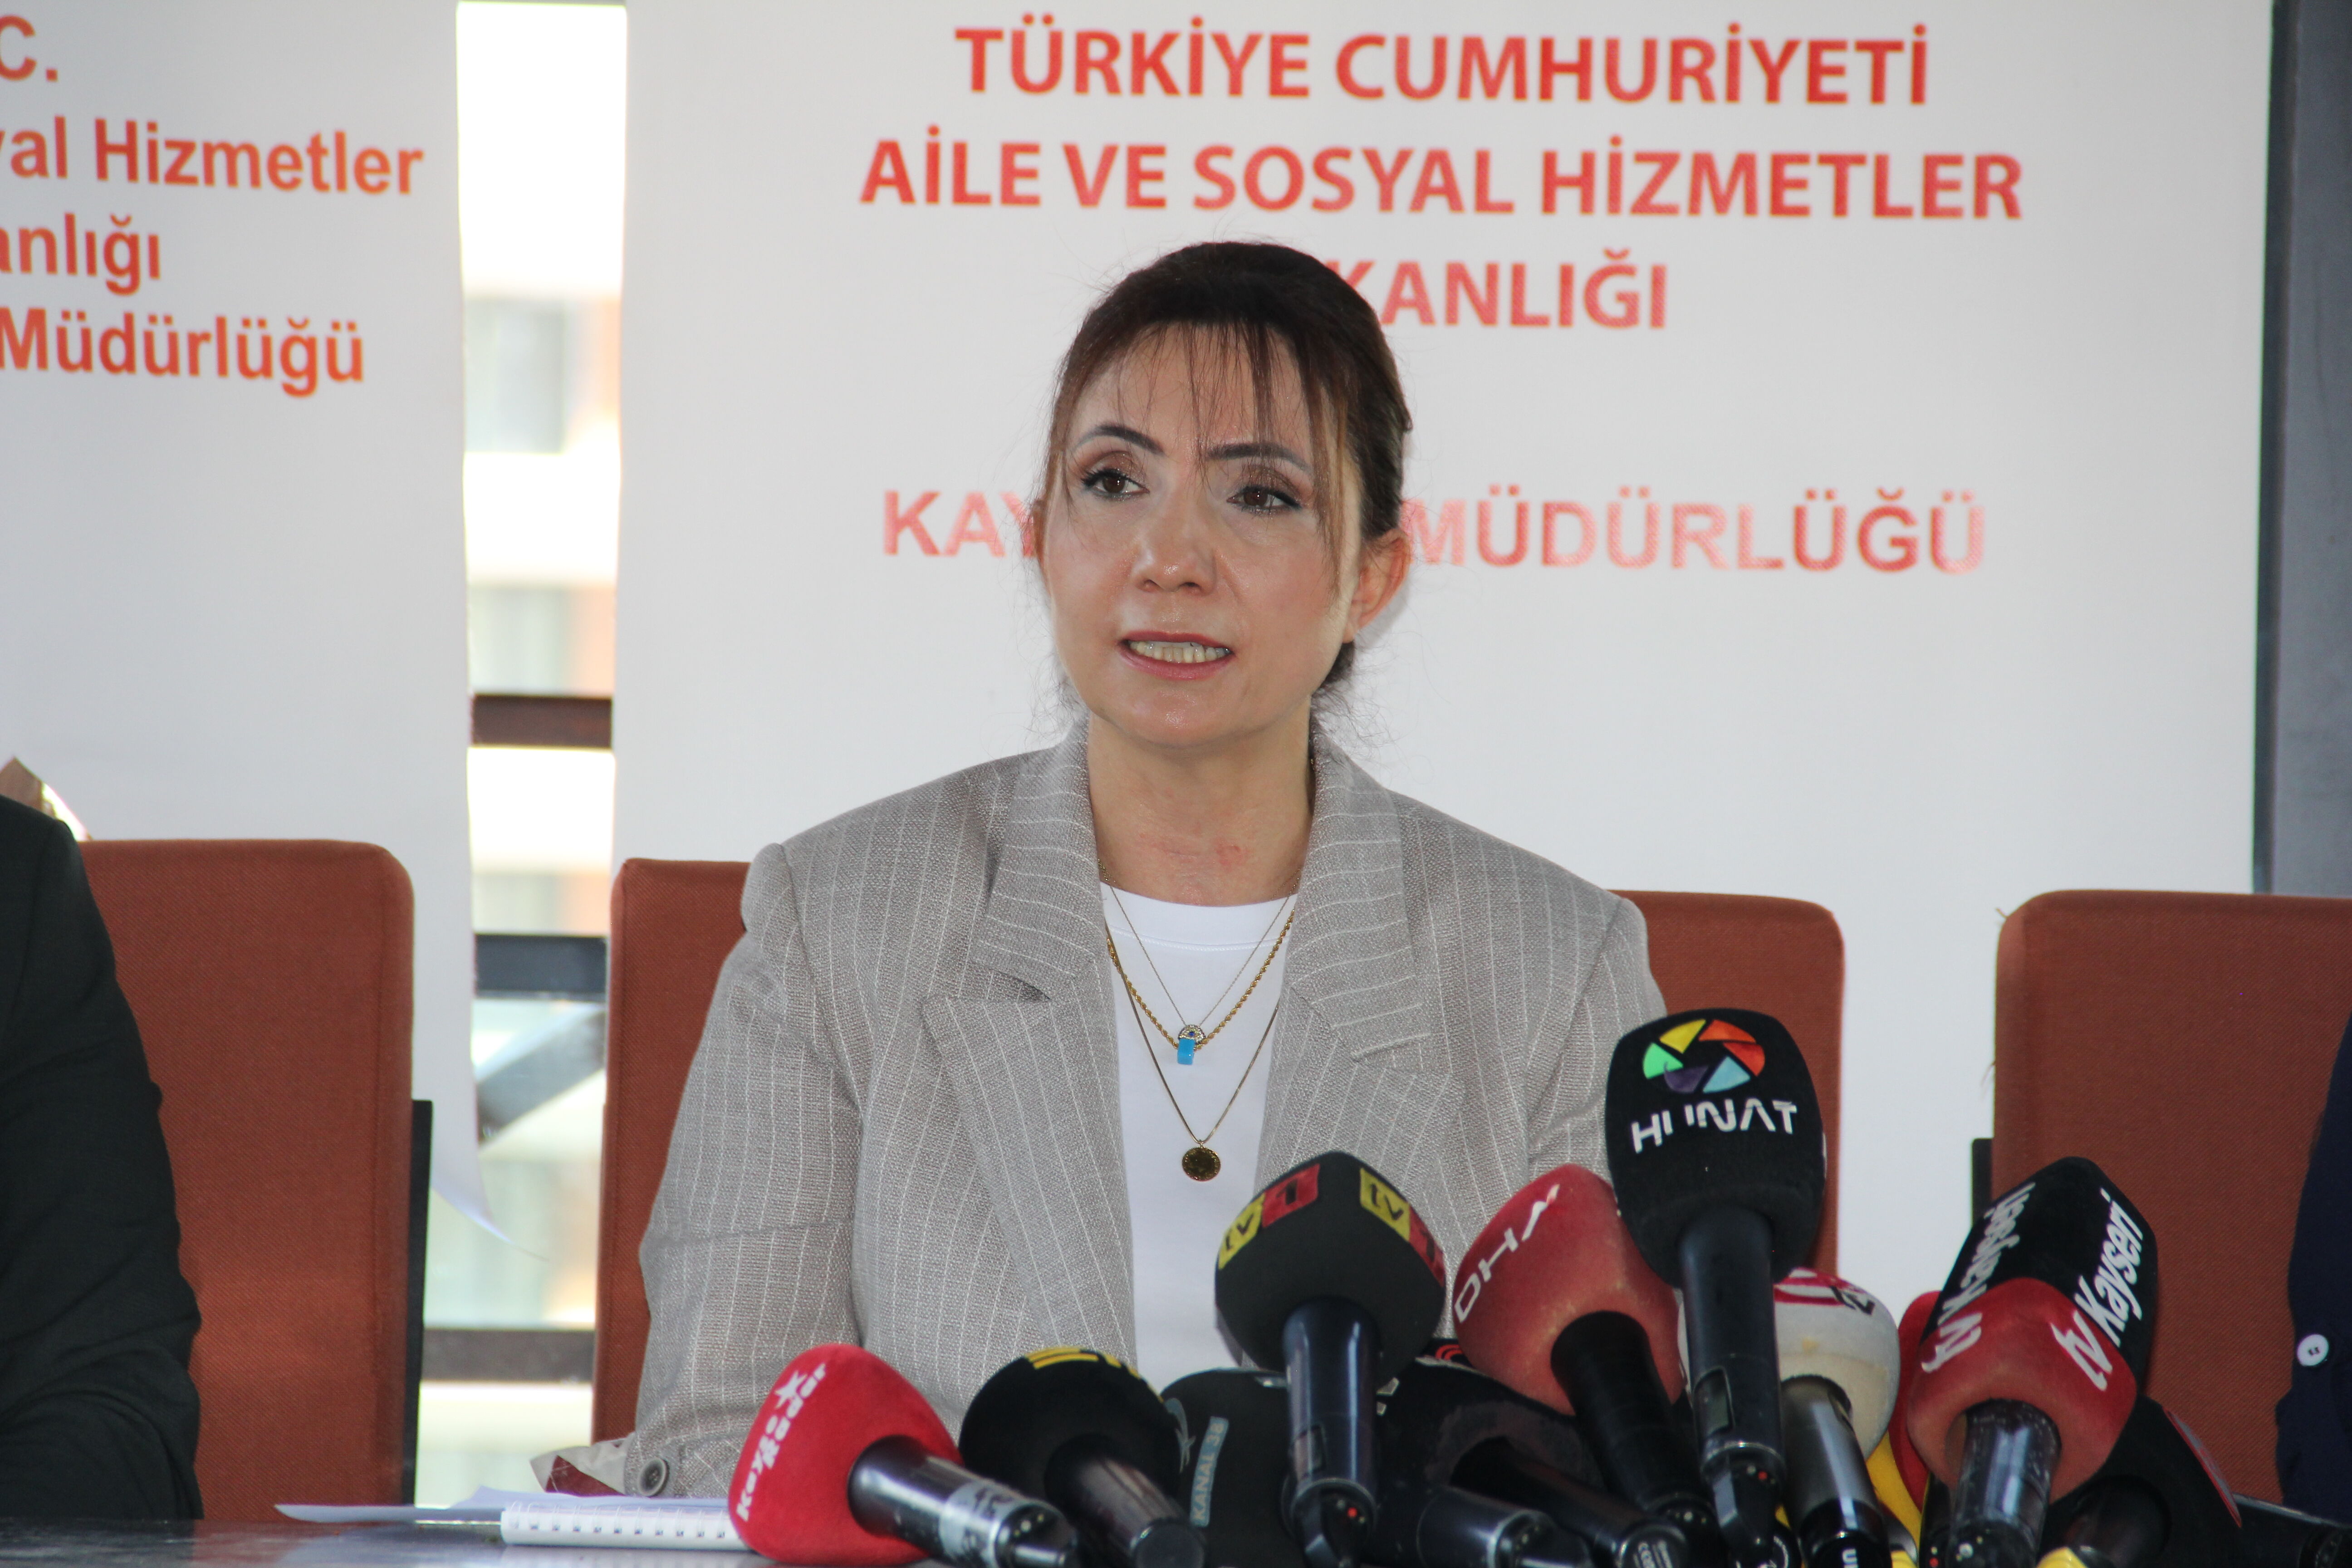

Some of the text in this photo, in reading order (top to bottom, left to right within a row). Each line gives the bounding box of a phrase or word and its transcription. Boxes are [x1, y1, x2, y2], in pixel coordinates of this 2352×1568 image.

[953, 10, 1929, 106] TÜRKİYE CUMHURİYETİ
[0, 114, 425, 196] al Hizmetler
[858, 122, 2024, 220] AİLE VE SOSYAL HİZMETLER
[0, 306, 364, 399] Müdürlüğü
[1401, 482, 1985, 575] MÜDÜRLÜĞÜ
[1192, 1453, 1215, 1520] KANAL
